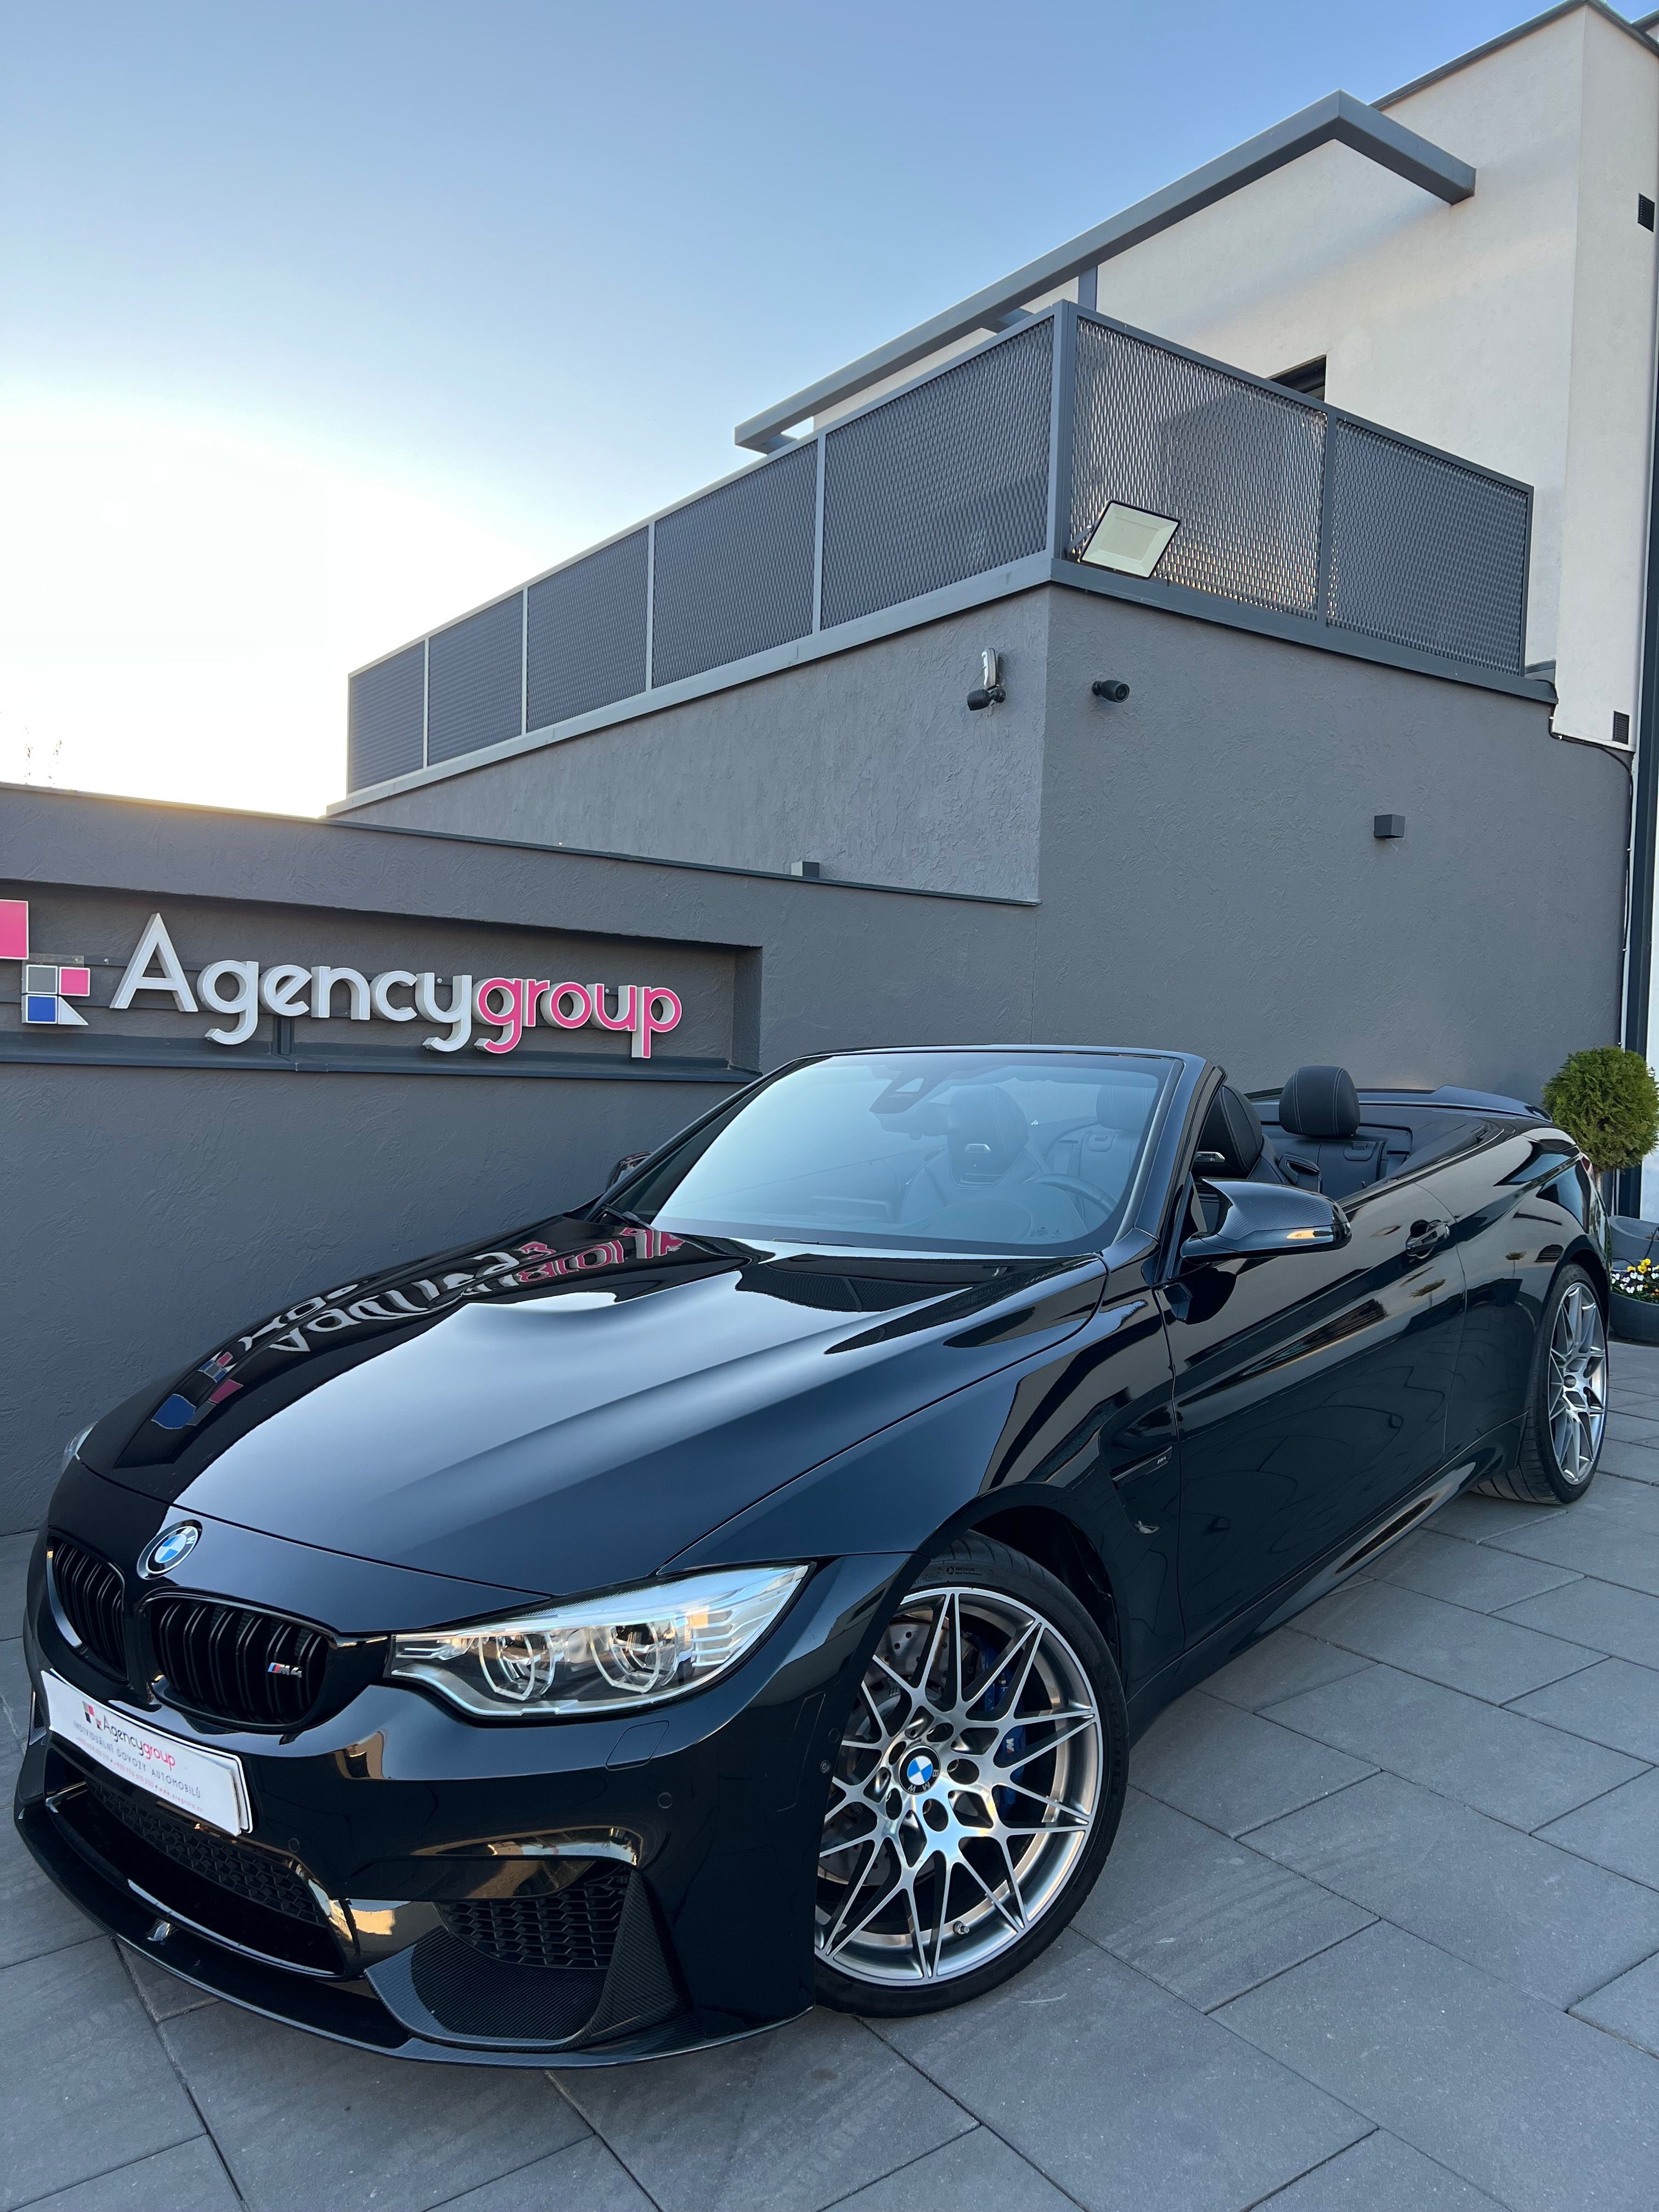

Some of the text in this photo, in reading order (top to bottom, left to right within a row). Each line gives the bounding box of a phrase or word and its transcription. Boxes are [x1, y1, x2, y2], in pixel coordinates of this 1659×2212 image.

[110, 912, 682, 1059] Agencygroup
[104, 1714, 176, 1771] Agencygroup
[117, 1749, 146, 1771] DOVOZY
[908, 1769, 939, 1793] BMW
